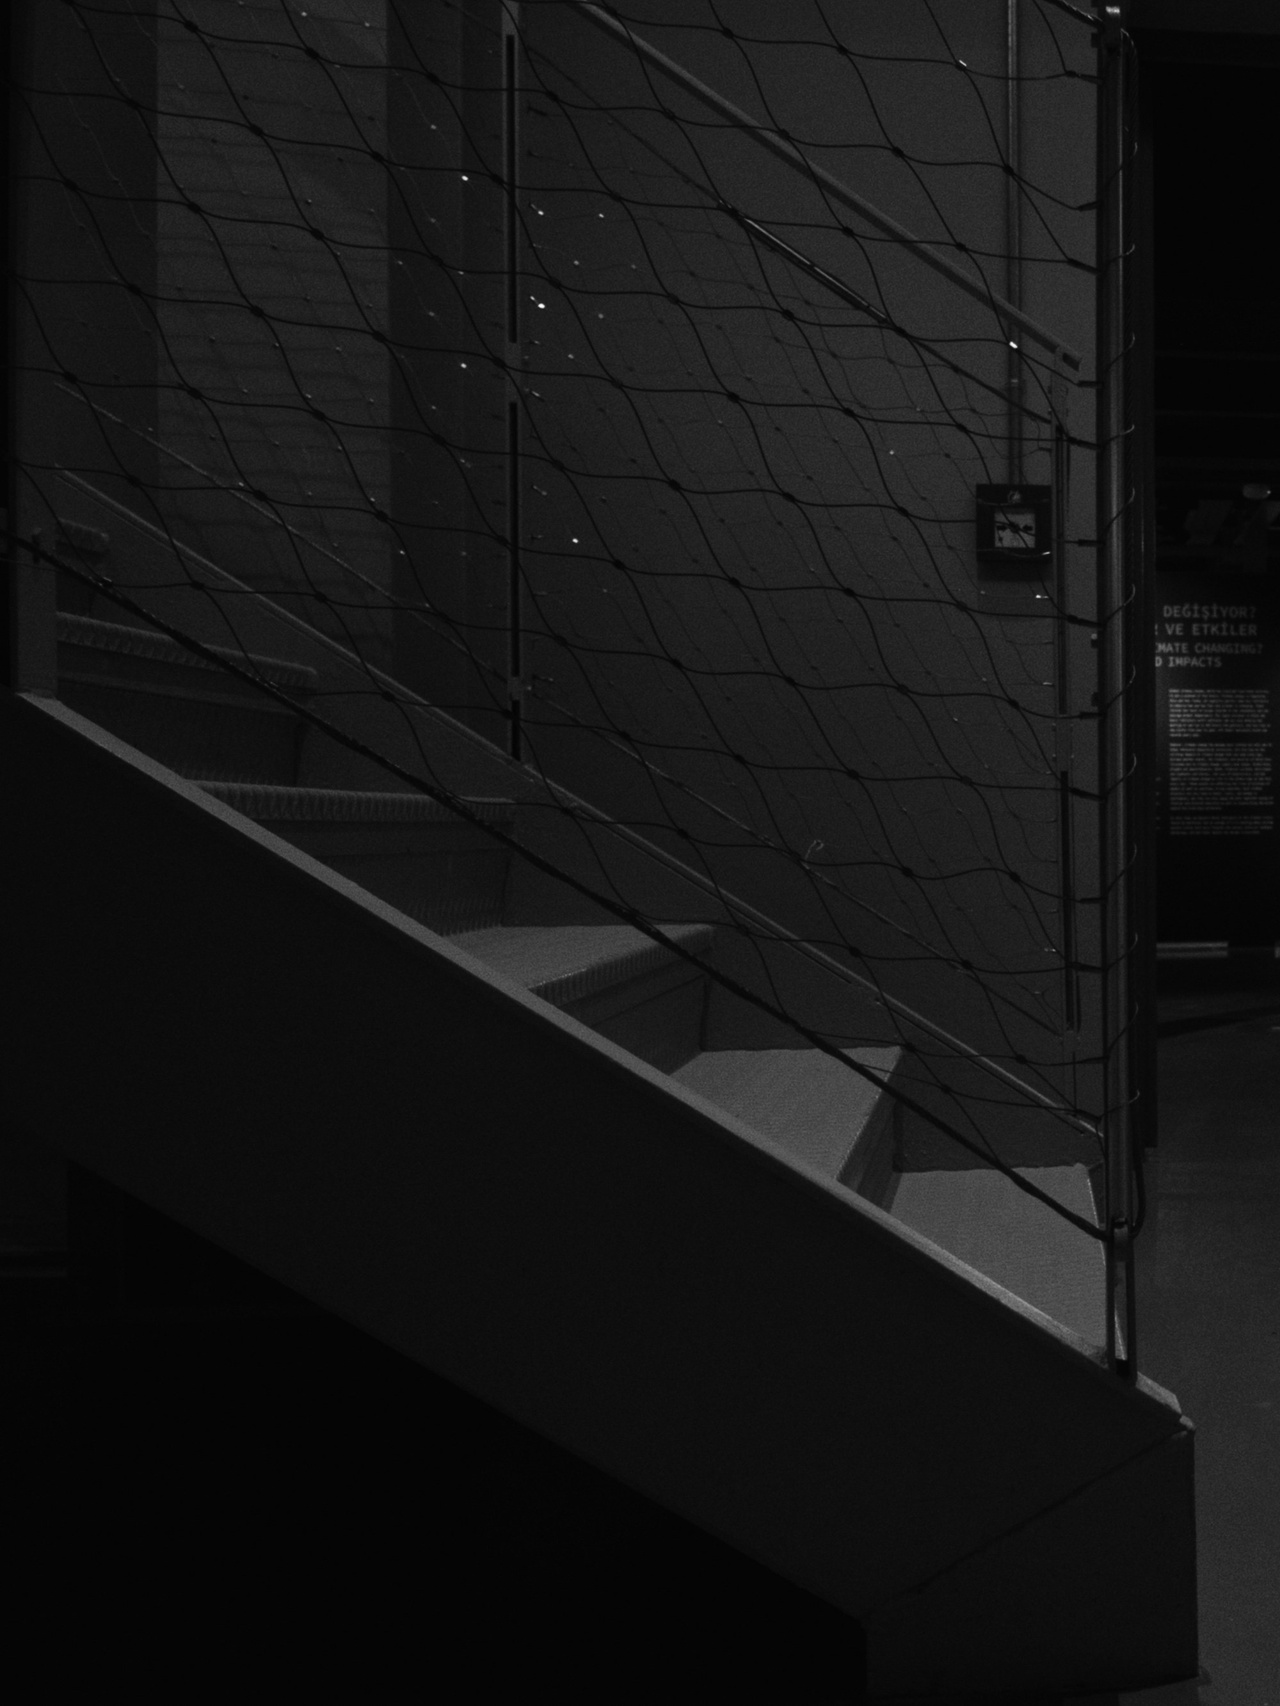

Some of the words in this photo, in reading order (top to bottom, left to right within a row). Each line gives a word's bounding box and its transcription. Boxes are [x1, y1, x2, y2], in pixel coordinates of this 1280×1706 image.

[1163, 602, 1257, 621] DEĞİŞİYOR?
[1165, 623, 1184, 636] VE
[1191, 621, 1258, 636] ETKİLER
[1194, 642, 1264, 655] CHANGING?
[1168, 656, 1223, 668] IMPACTS
